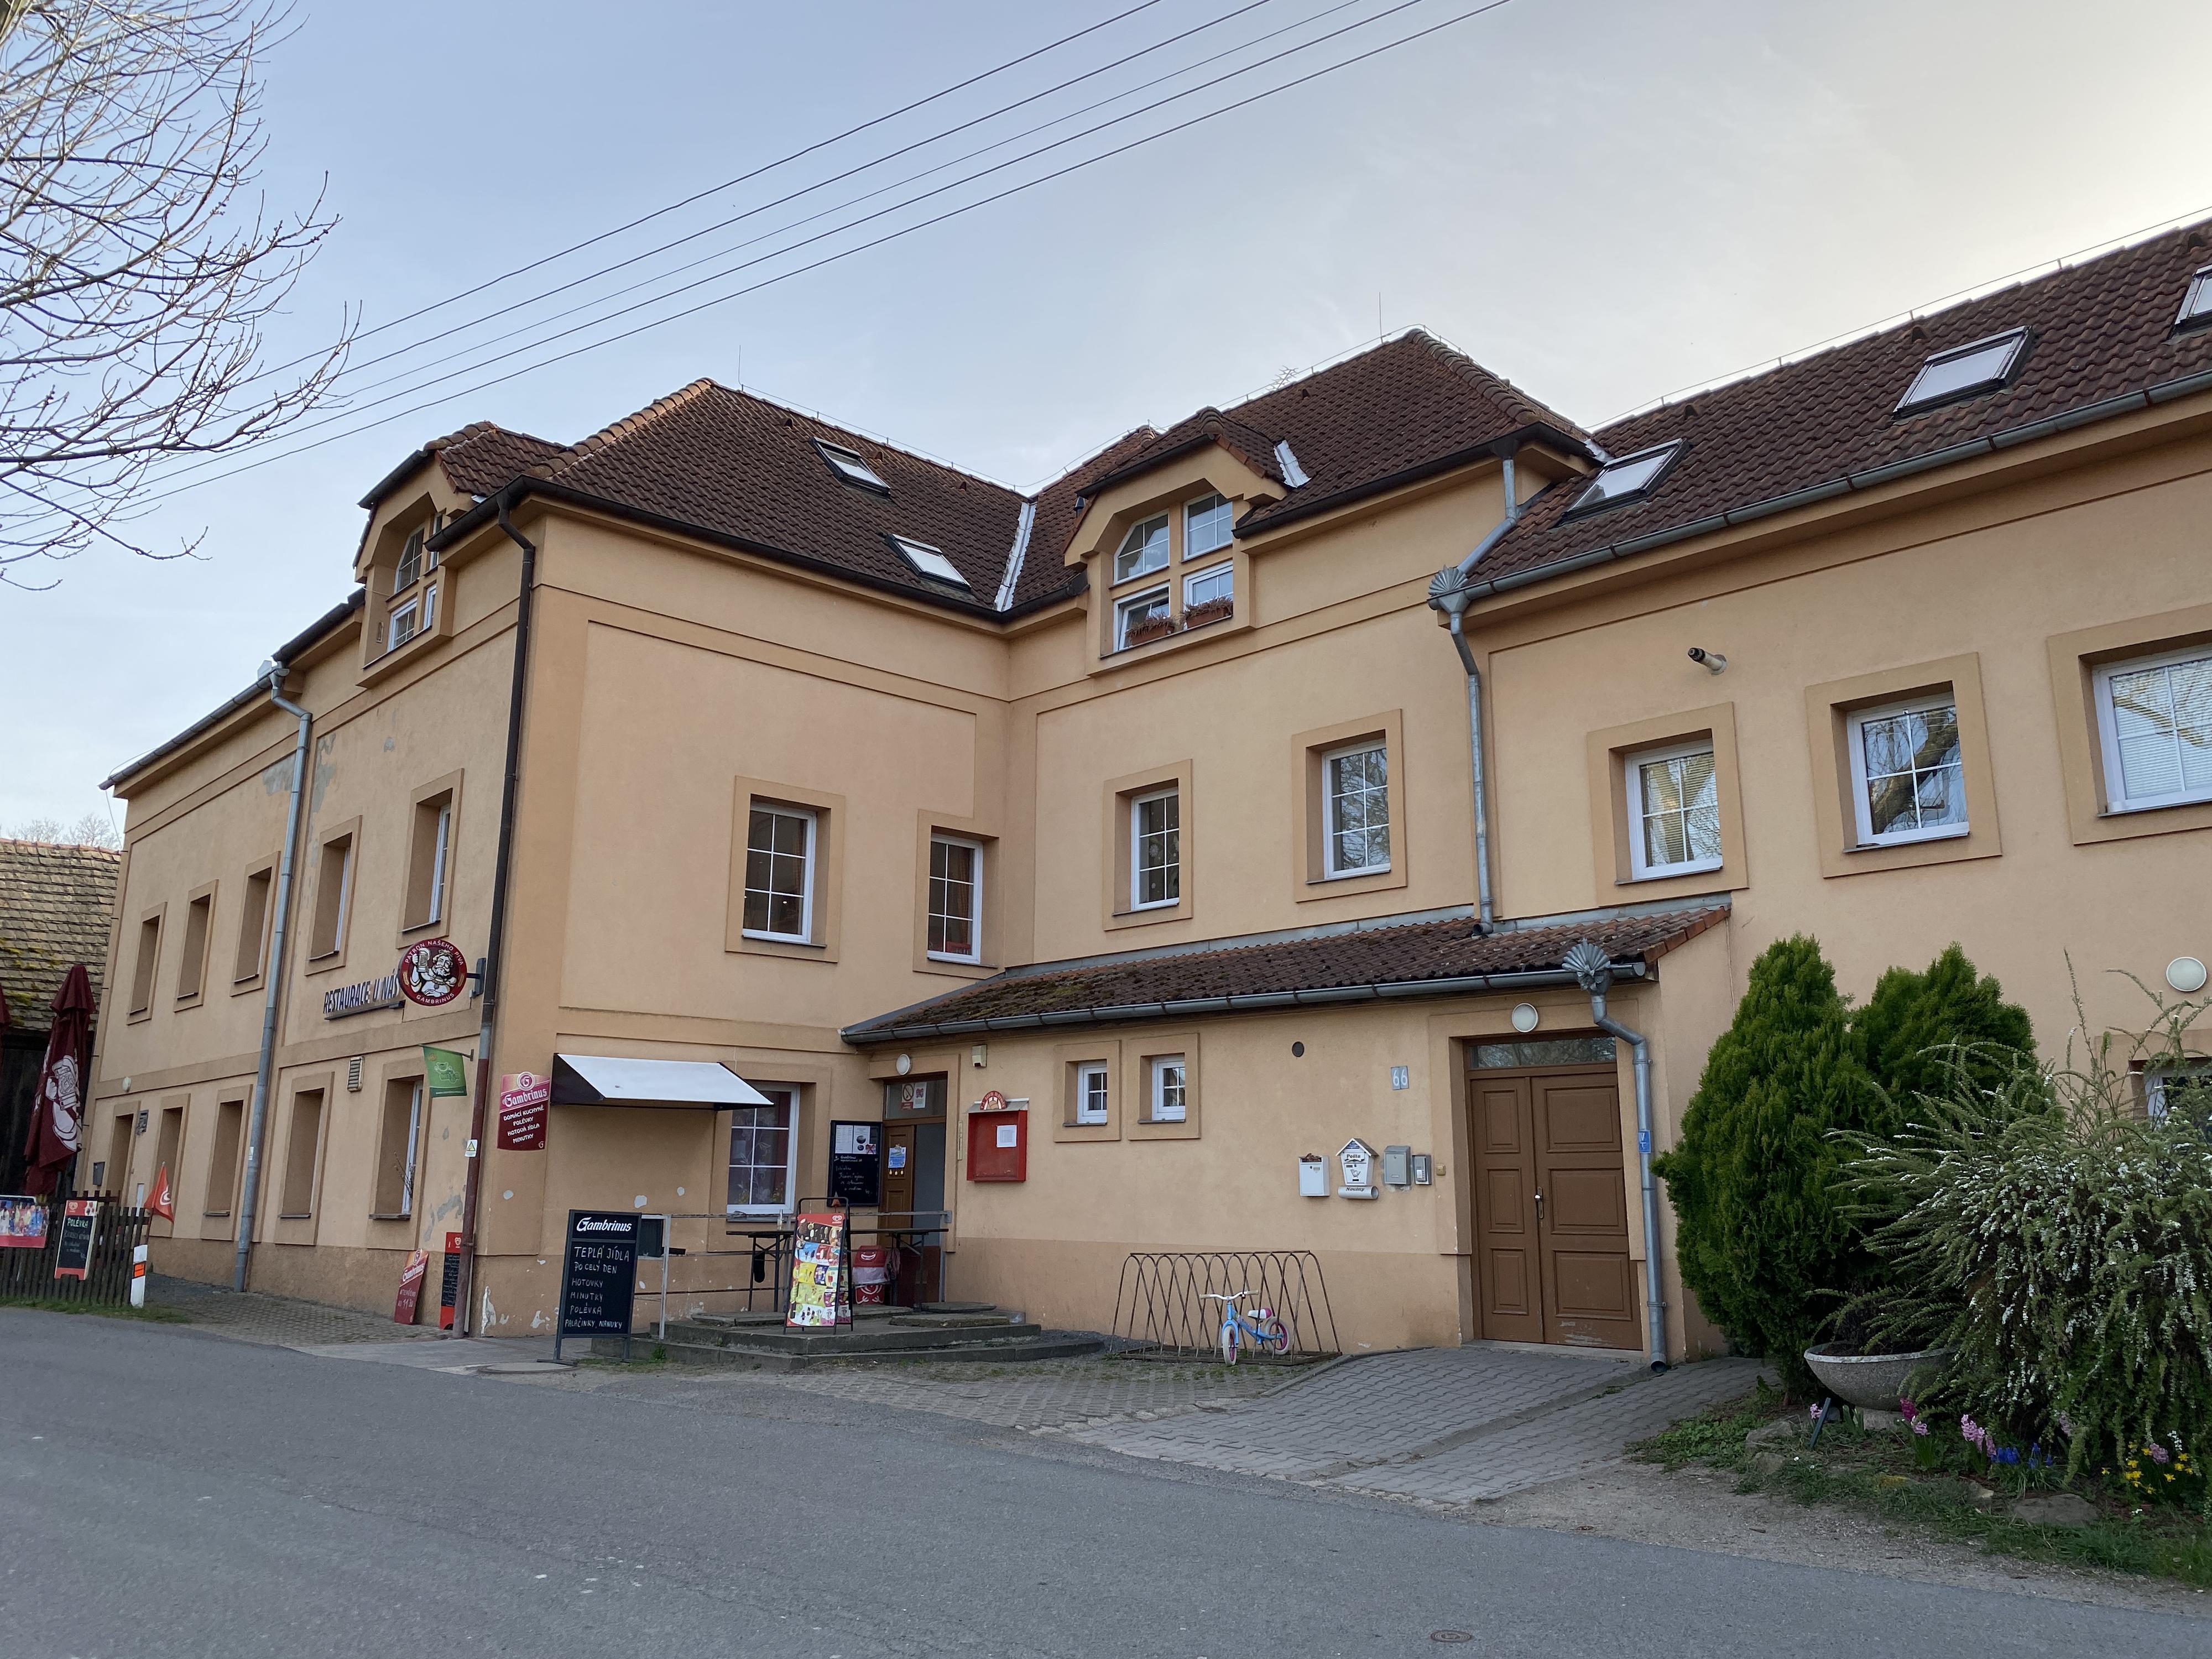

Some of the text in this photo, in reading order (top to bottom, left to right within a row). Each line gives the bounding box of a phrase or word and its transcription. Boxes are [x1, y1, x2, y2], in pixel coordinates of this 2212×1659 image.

[405, 940, 464, 965] PATRON NAŠEHO PIVA
[323, 980, 372, 1014] RESTAURACE
[373, 978, 380, 1002] U
[416, 993, 454, 1004] GAMBRINUS
[1393, 1069, 1407, 1086] 66
[502, 1088, 547, 1107] Gambrinus
[503, 1110, 522, 1121] DOMÁCÍ
[513, 1117, 534, 1126] POLÉVKY
[513, 1134, 534, 1144] MINUTKY
[576, 1217, 633, 1232] Gambrinus
[574, 1245, 630, 1262] TEPLÁ JÍDLA
[574, 1260, 617, 1274] PO CELÝ DEN
[571, 1278, 603, 1288] HOTOVKY
[570, 1291, 603, 1301] MINUTKY
[570, 1302, 602, 1315] POLÉVKA
